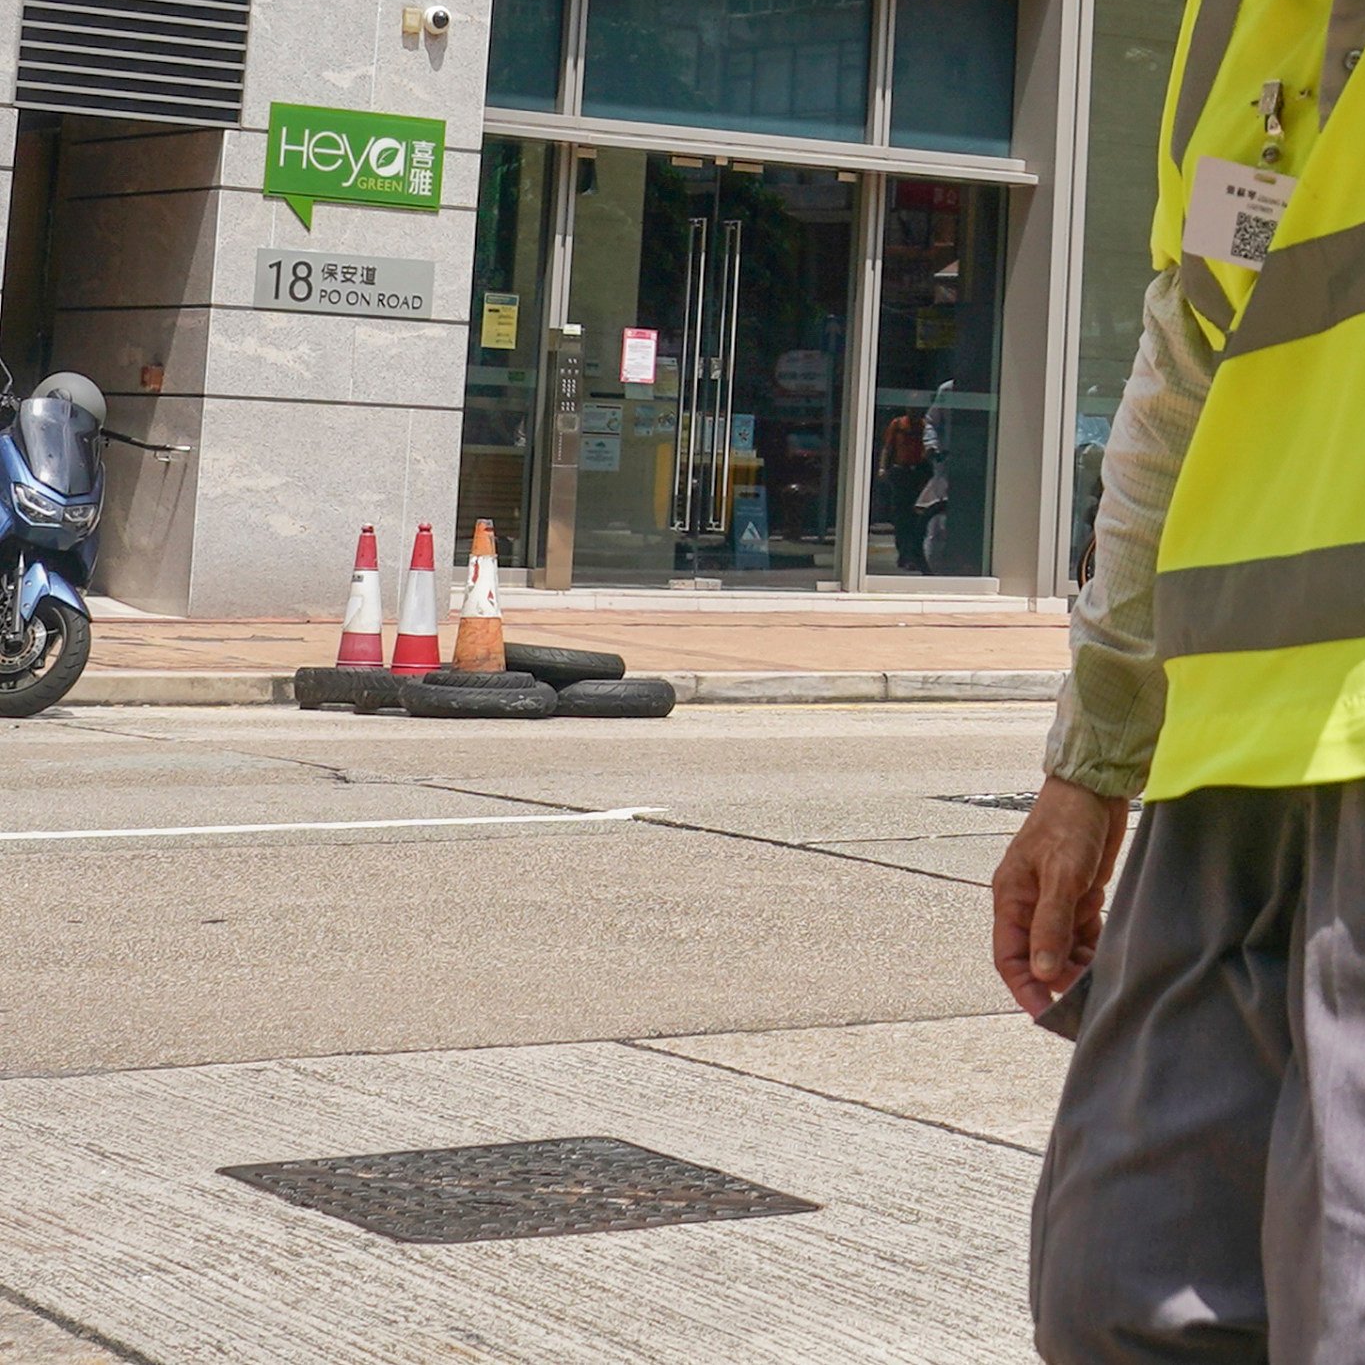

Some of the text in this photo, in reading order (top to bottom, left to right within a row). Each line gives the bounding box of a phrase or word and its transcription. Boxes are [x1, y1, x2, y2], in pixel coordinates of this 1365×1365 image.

[408, 140, 436, 197] 喜雅
[357, 176, 403, 193] GREEN
[268, 259, 314, 303] 18
[321, 263, 377, 286] 保安道
[318, 289, 424, 310] PO ON ROAD
